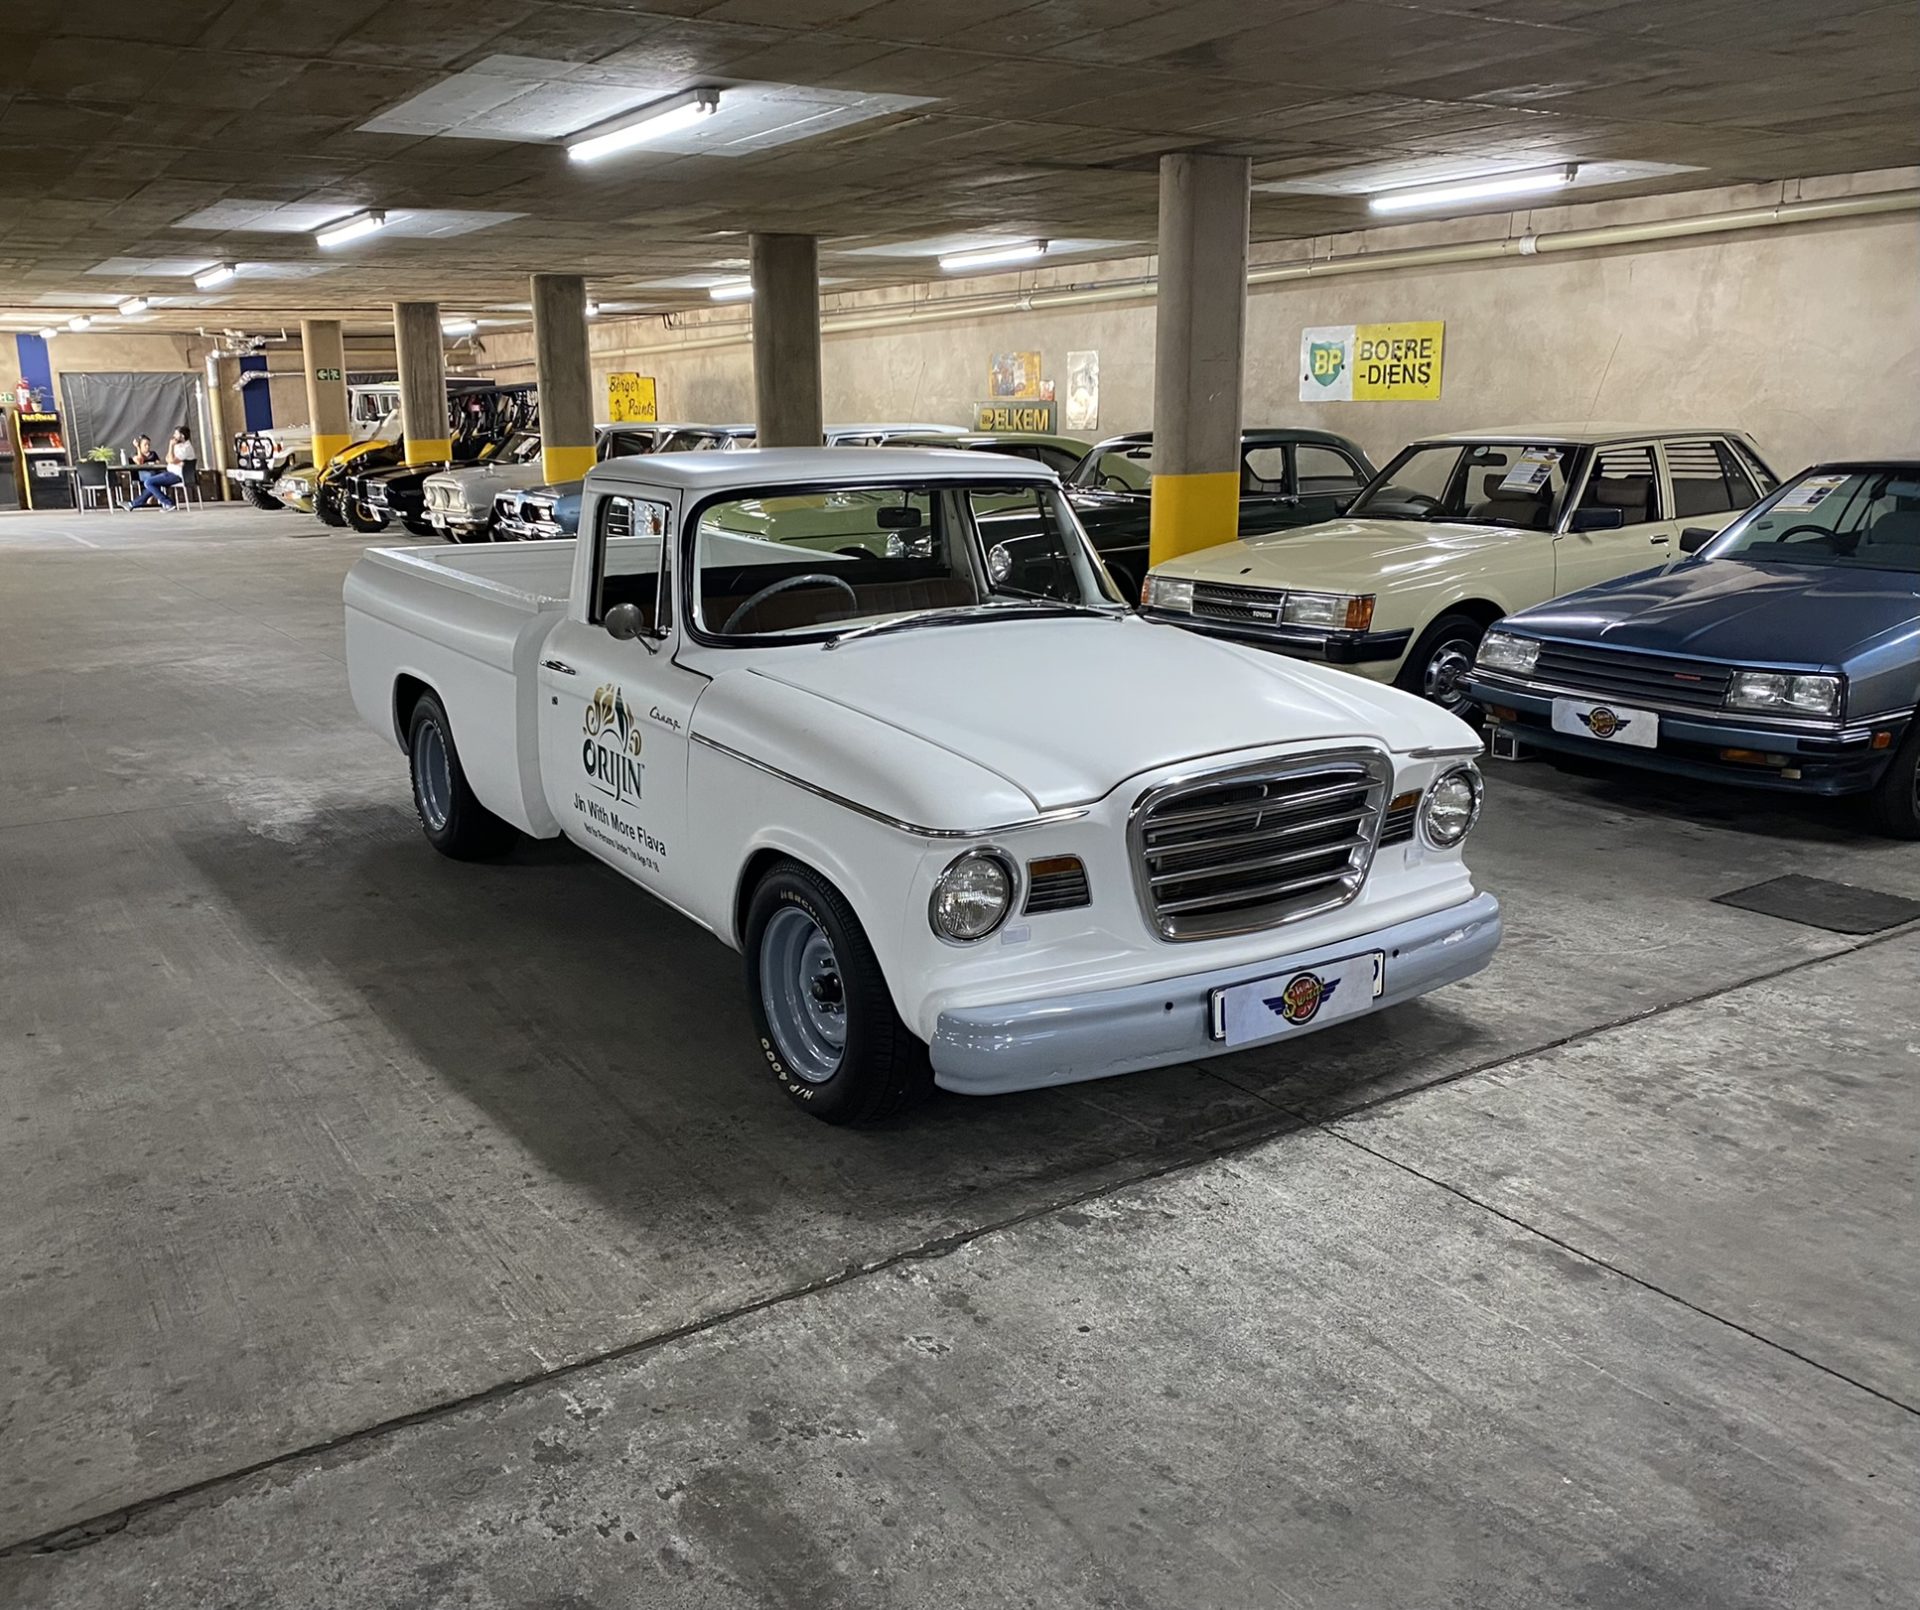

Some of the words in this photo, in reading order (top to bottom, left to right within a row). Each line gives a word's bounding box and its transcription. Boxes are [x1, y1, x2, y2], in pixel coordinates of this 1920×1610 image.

[1360, 338, 1433, 361] BOERE
[1314, 349, 1342, 375] BP
[1359, 361, 1432, 385] -DIENS
[609, 376, 640, 398] Berger
[628, 398, 655, 416] Paints
[583, 738, 642, 801] ORIJIN
[573, 792, 587, 813] Jin
[587, 799, 610, 826] With
[610, 811, 636, 840] More
[637, 825, 667, 857] Flava
[760, 1037, 789, 1081] 4000
[789, 1084, 814, 1100] H/P
